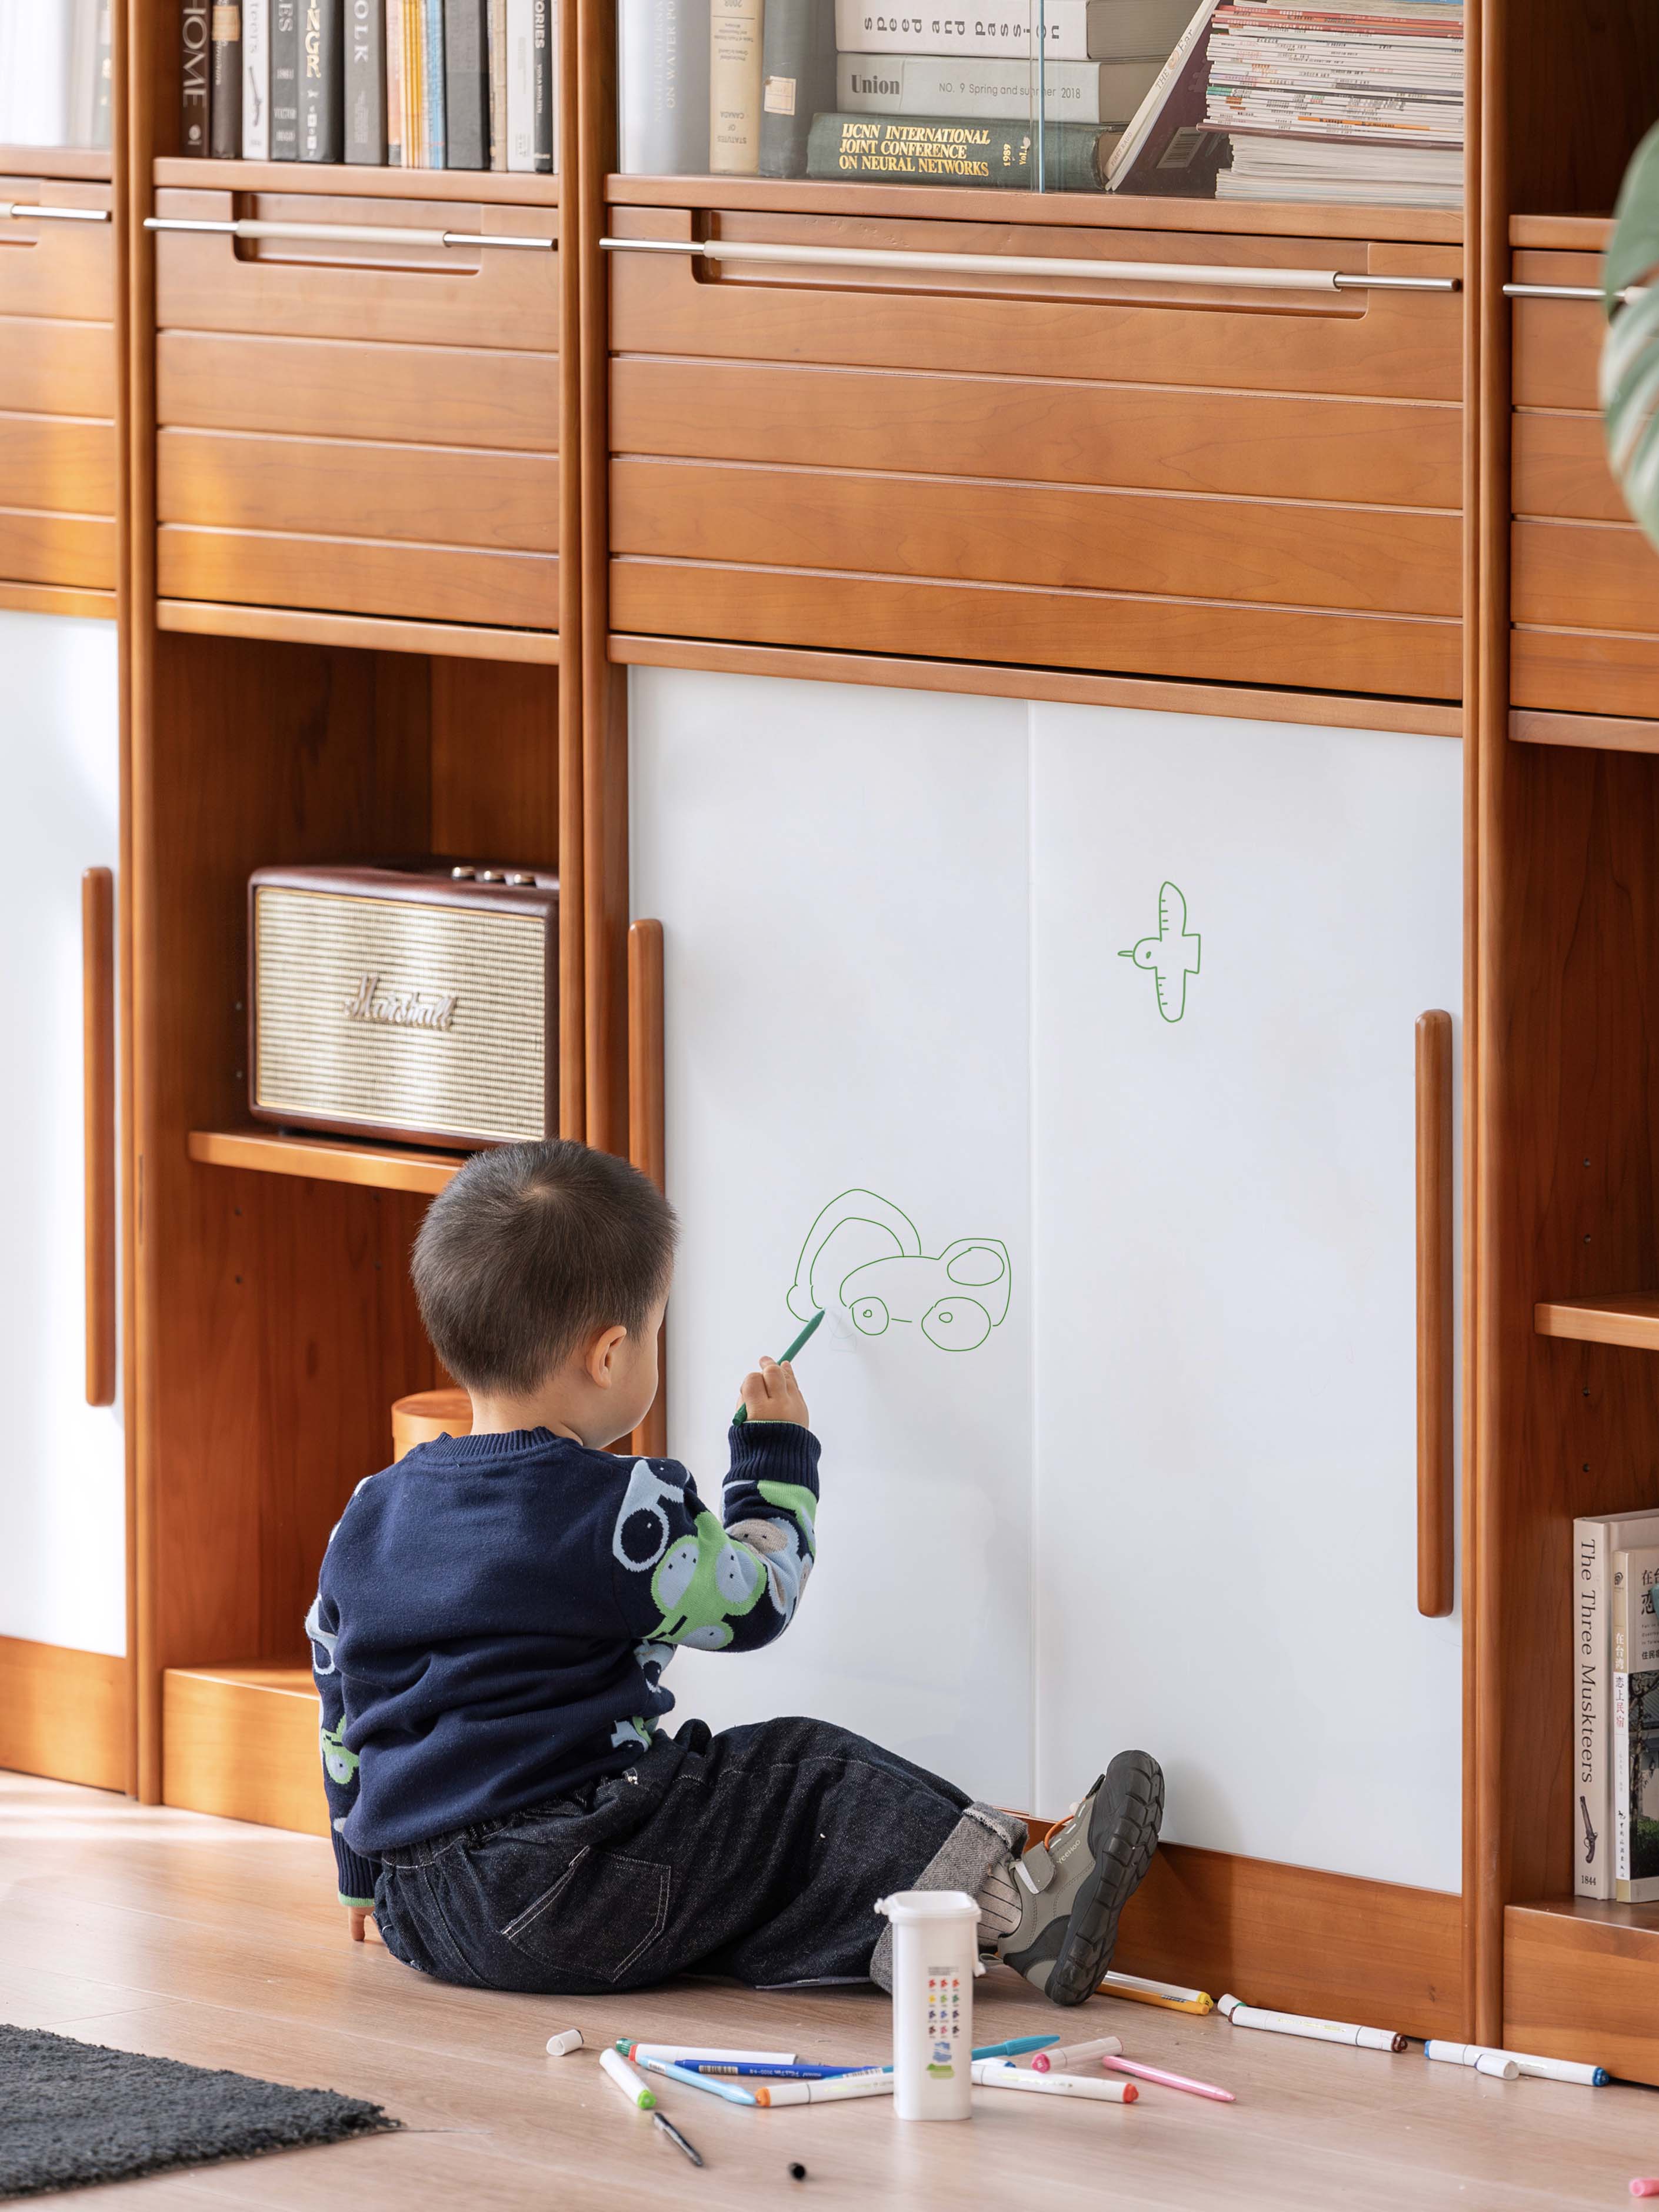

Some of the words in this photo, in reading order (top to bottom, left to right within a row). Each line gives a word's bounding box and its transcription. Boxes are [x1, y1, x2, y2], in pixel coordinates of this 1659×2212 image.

[535, 0, 545, 49] ORIES
[864, 16, 922, 34] speed
[931, 19, 965, 36] and
[851, 74, 900, 95] Union
[939, 83, 955, 93] NO.
[960, 84, 965, 94] 9
[969, 84, 998, 96] Spring
[1000, 85, 1018, 95] and
[1061, 87, 1081, 99] 2018
[1155, 69, 1170, 91] THE
[841, 123, 881, 139] IJCNN
[885, 125, 991, 145] INTERNATIONAL
[840, 139, 877, 155] JOINT
[880, 141, 968, 160] CONFERENCE
[1002, 142, 1011, 166] 1989
[839, 155, 858, 170] ON
[861, 156, 915, 172] NEURAL
[918, 158, 989, 176] NETWORKS
[344, 974, 458, 1031] Marshall
[1581, 1538, 1595, 1581] The
[1581, 1590, 1596, 1655] Three
[1581, 1663, 1596, 1783] Muskteers
[1581, 1874, 1597, 1886] 1844
